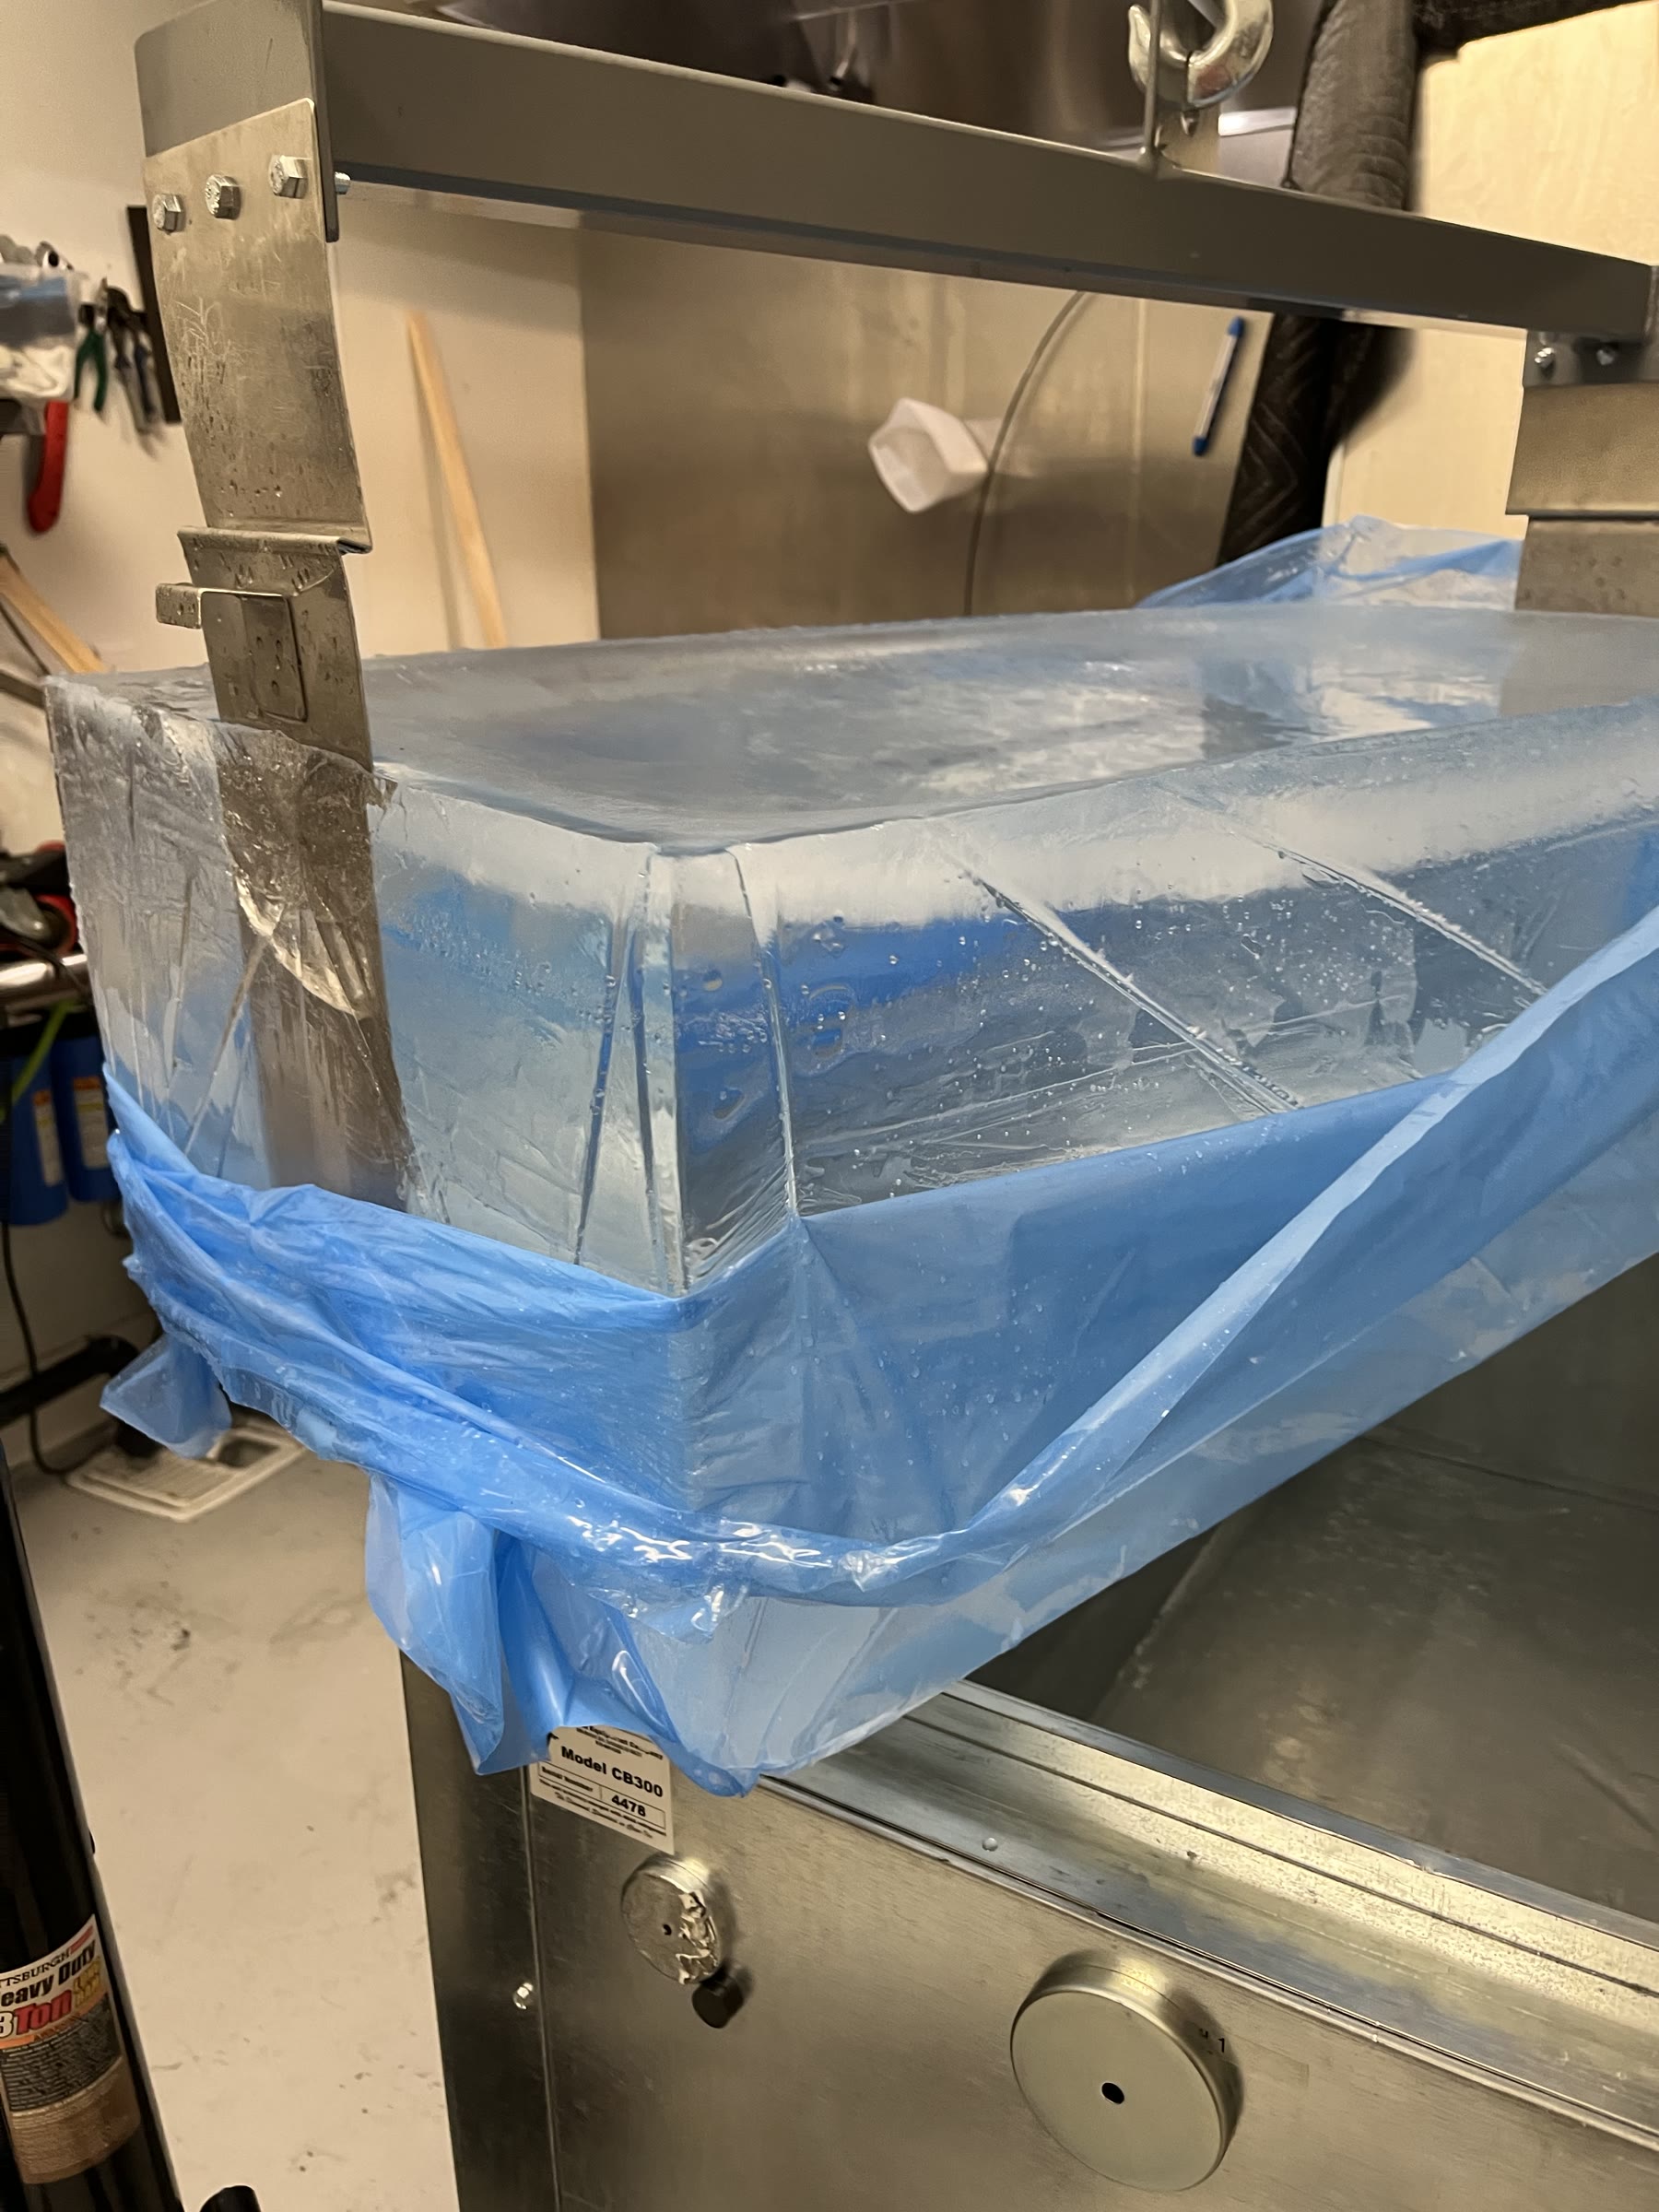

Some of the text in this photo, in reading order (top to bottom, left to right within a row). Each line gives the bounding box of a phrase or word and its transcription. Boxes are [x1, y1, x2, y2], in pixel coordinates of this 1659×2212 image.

[561, 1747, 606, 1774] Model
[612, 1767, 663, 1797] CB300
[612, 1794, 646, 1817] 4478
[0, 1975, 54, 2007] eavy
[58, 1939, 96, 1985] Duty
